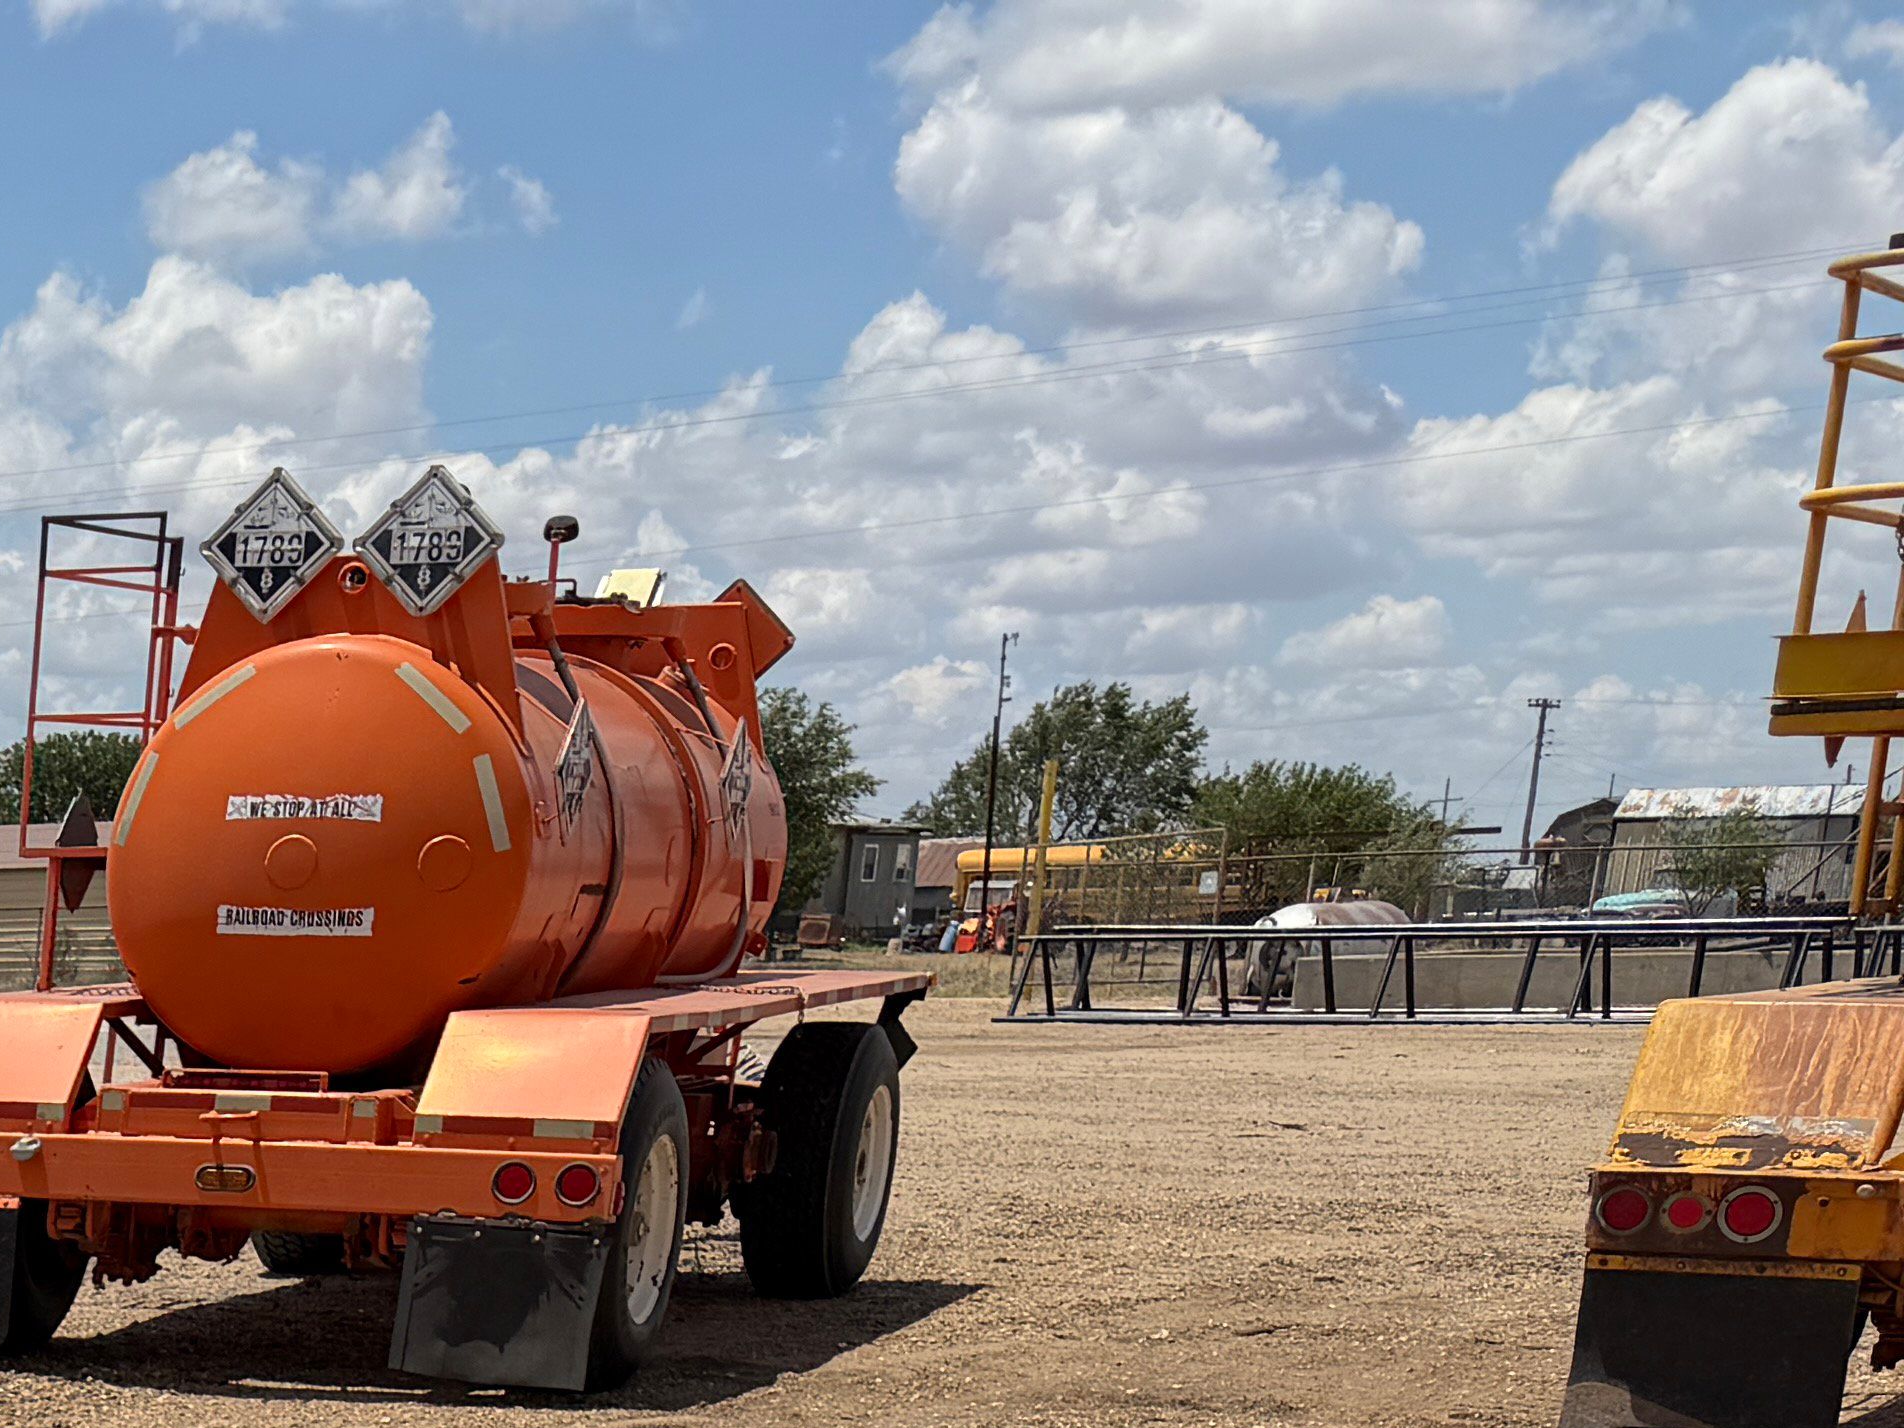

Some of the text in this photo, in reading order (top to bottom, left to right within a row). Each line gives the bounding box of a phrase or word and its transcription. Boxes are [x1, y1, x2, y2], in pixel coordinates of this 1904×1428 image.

[240, 533, 302, 565] 1789
[396, 531, 462, 562] 1789
[273, 802, 304, 817] STOP
[331, 801, 353, 817] ALL
[226, 908, 285, 926] RAILROAD
